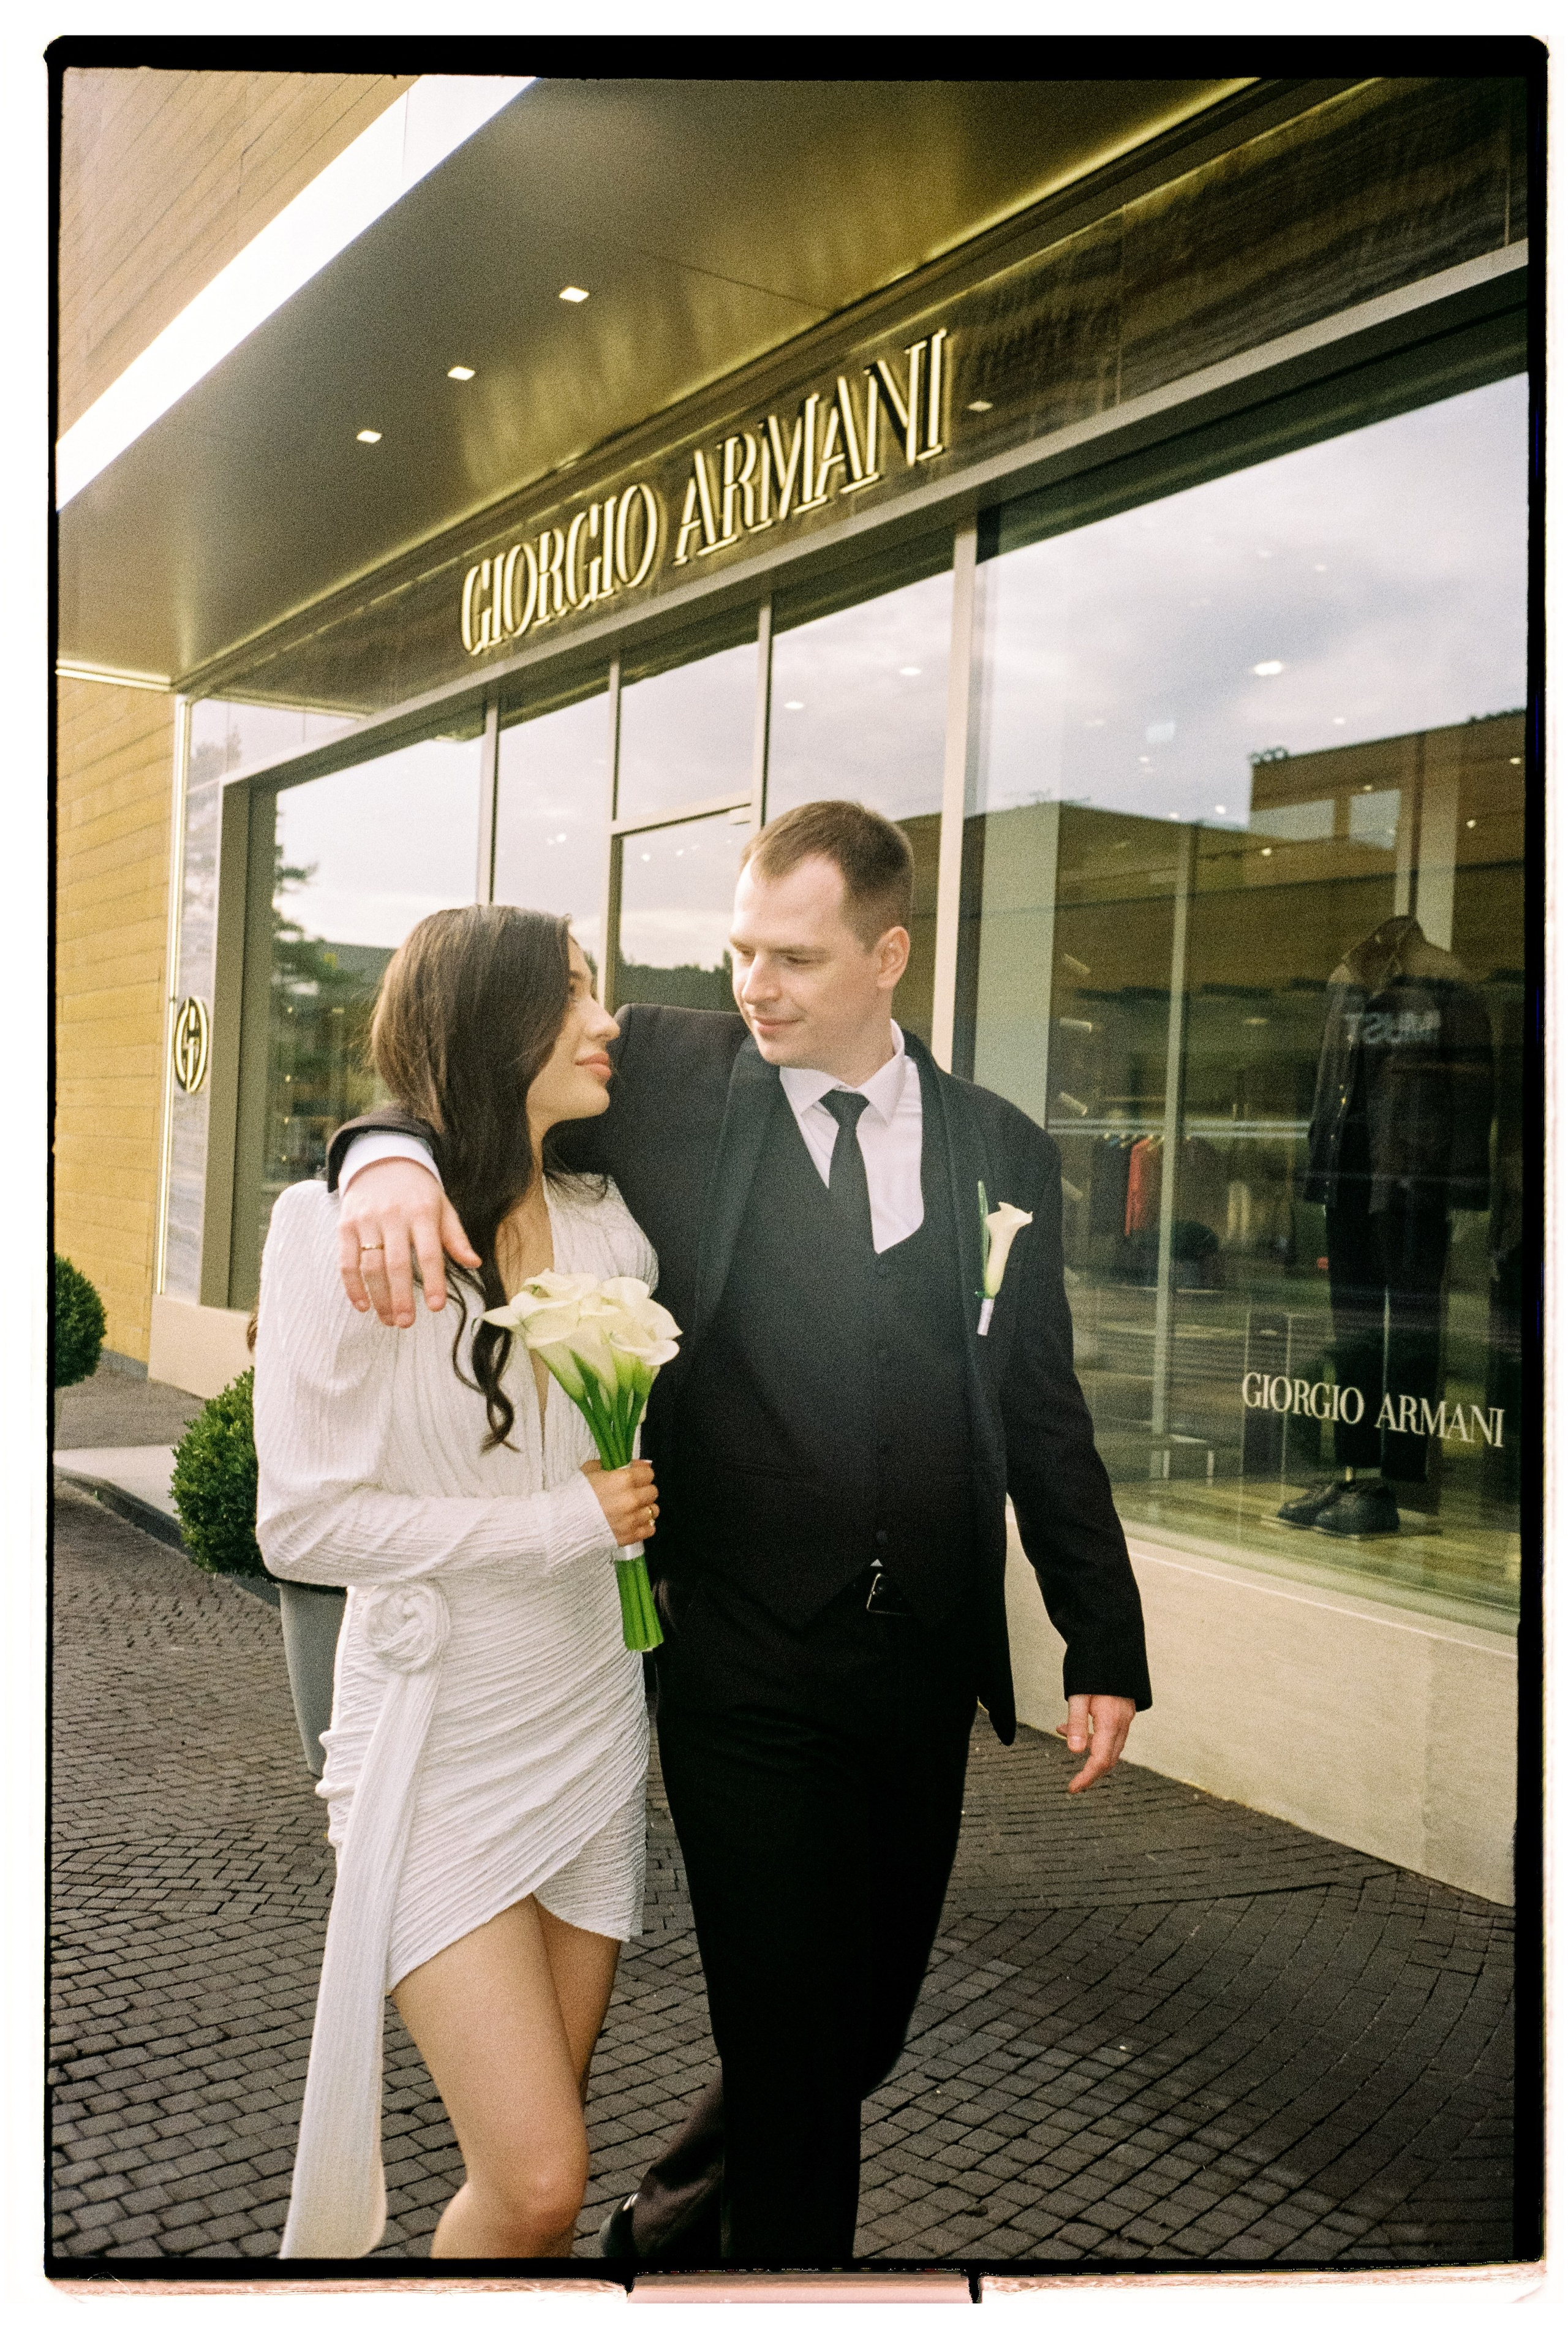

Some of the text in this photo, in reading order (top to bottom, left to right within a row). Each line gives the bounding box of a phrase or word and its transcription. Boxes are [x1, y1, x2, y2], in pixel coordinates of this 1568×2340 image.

[461, 328, 948, 655] GIORGIO ARMANI
[1242, 1372, 1505, 1447] GIORGIO ARMANI
